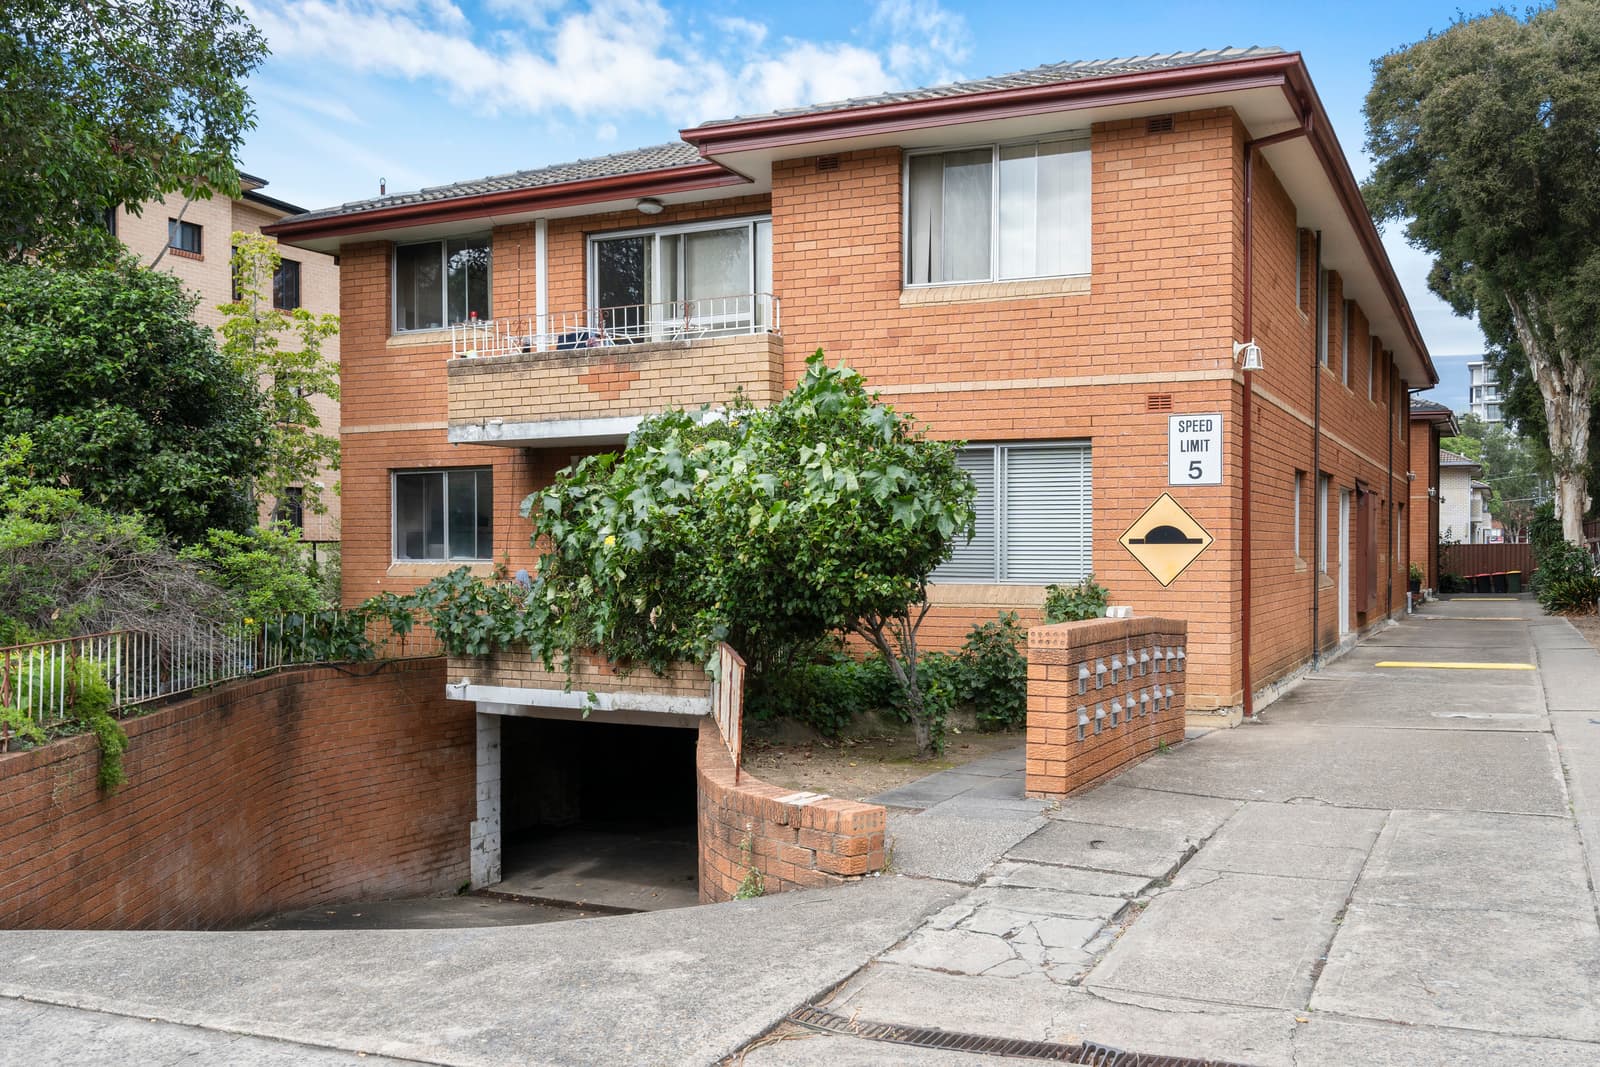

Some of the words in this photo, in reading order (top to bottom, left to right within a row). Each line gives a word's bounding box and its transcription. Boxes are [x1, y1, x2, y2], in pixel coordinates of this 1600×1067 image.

[1178, 419, 1213, 433] SPEED
[1180, 439, 1210, 453] LIMIT
[1188, 460, 1203, 480] 5
